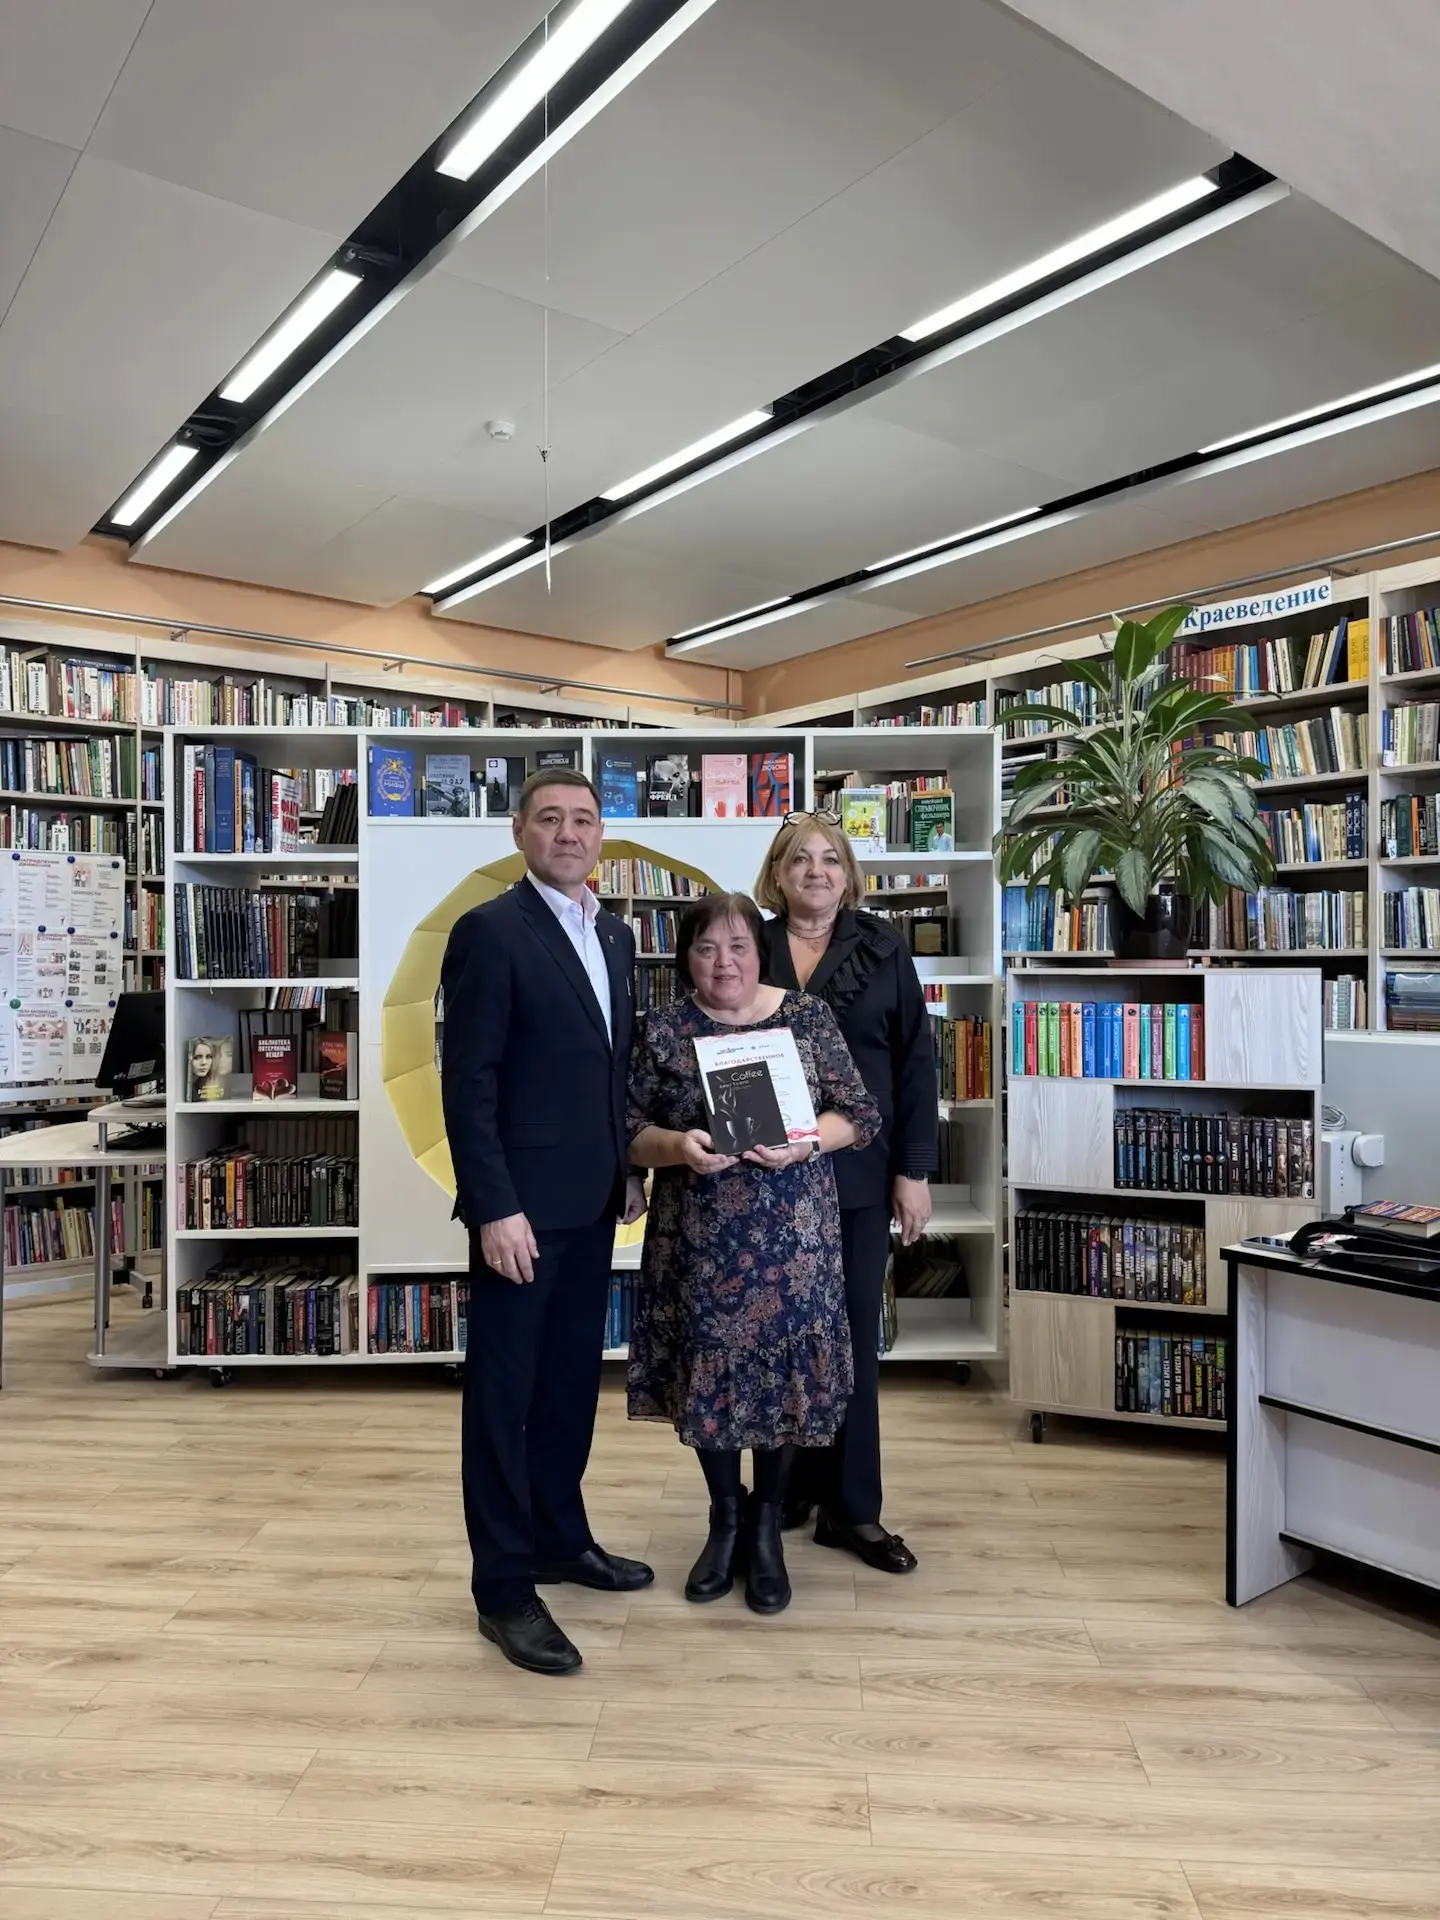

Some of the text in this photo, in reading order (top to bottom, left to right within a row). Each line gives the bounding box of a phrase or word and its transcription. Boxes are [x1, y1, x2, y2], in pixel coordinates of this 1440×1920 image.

[1184, 583, 1330, 631] Краеведение
[914, 803, 951, 813] СПРАВОЧНИК
[265, 1051, 285, 1059] ВЕЩЕЙ
[714, 1053, 785, 1067] БЛАГОДАРСТВЕННОЕ
[730, 1068, 764, 1083] Coffee
